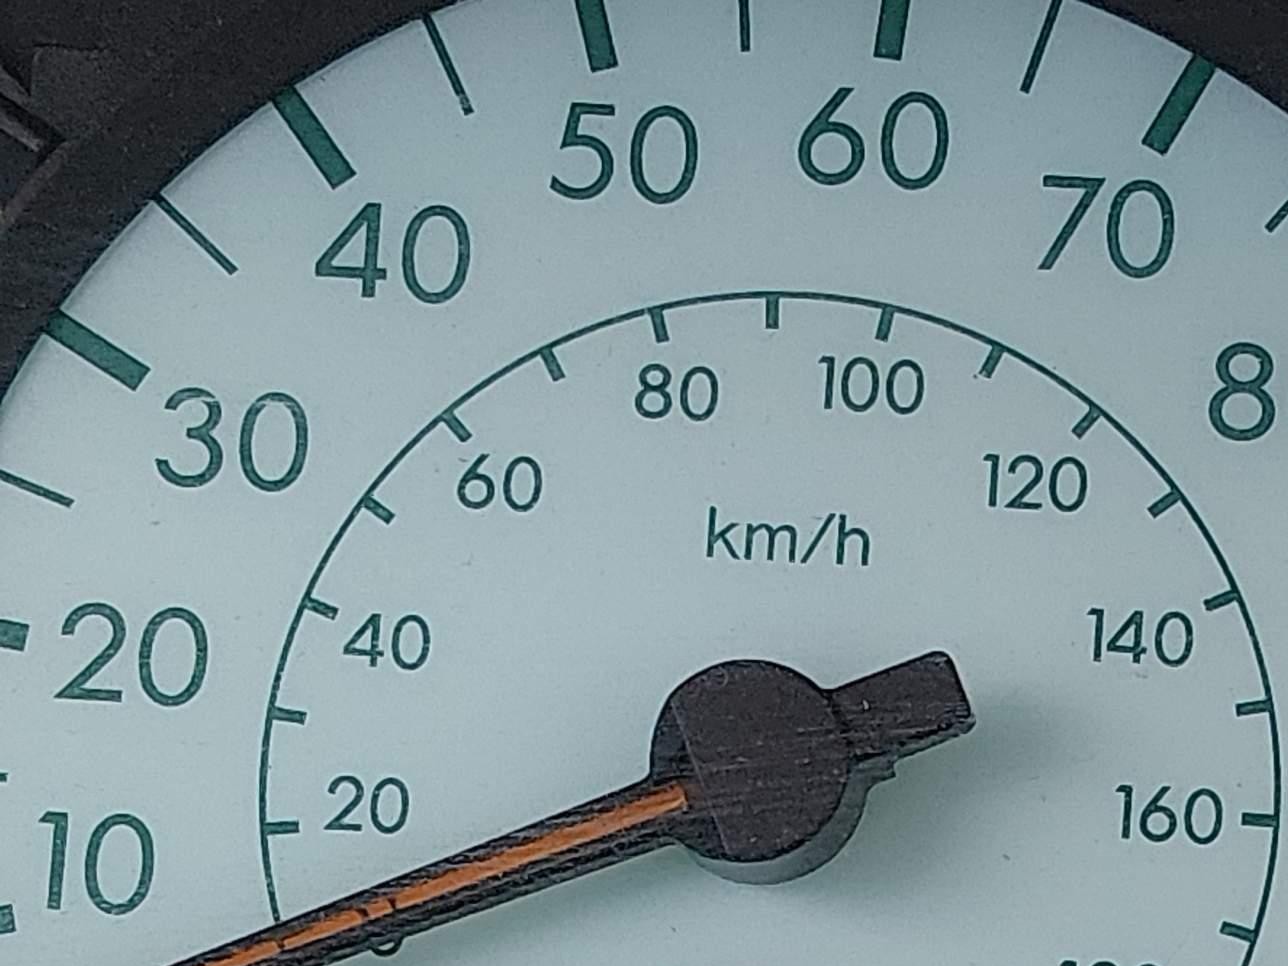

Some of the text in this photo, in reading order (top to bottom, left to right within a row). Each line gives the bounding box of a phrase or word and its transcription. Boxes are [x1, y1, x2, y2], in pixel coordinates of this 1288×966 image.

[550, 102, 698, 204] 50
[798, 87, 949, 190] 60
[315, 203, 470, 304] 40
[1038, 175, 1174, 278] 70
[635, 364, 718, 421] 80
[819, 356, 924, 414] 100
[155, 387, 308, 492] 30
[457, 454, 542, 511] 60
[984, 454, 1087, 512] 120
[707, 506, 869, 566] km/h
[54, 603, 208, 706] 20
[343, 614, 430, 670] 40
[1088, 608, 1193, 667] 140
[324, 776, 409, 834] 20
[1116, 785, 1222, 844] 160
[39, 811, 154, 915] 10
